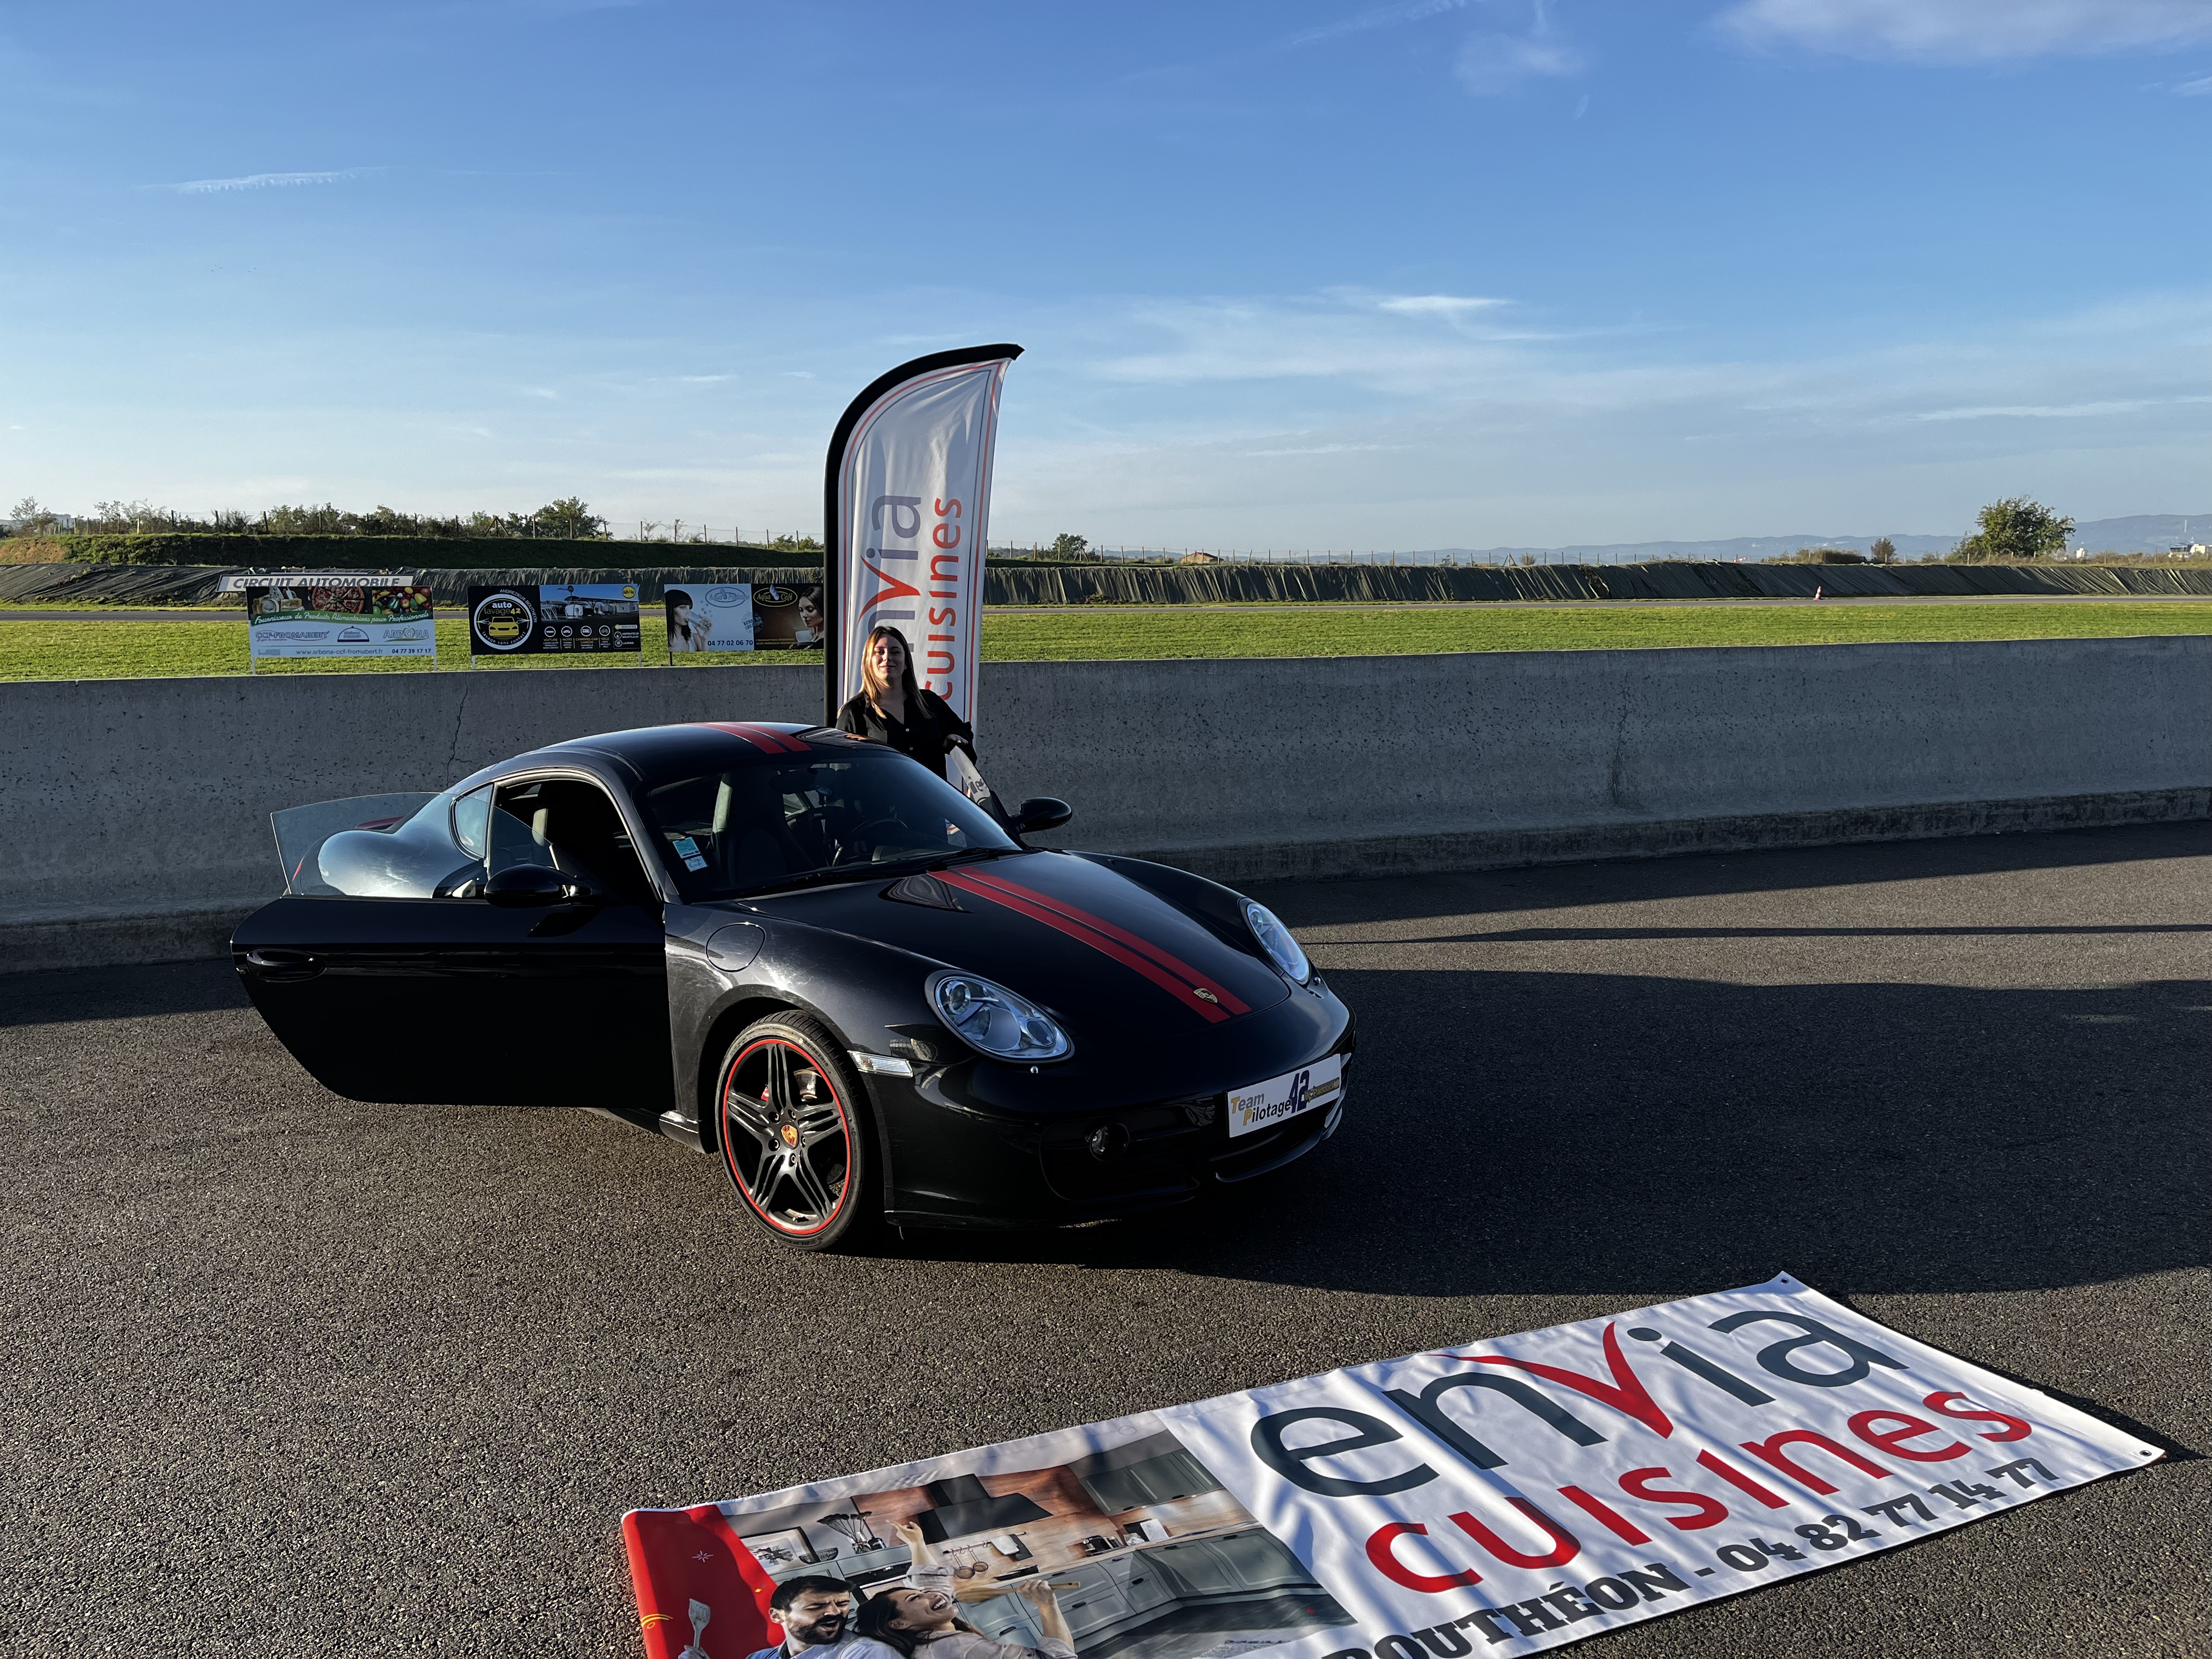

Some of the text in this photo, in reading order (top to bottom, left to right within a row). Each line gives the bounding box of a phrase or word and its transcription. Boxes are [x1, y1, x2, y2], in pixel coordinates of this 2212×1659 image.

[233, 578, 399, 588] CIRCUIT AUTOMOBILE
[857, 494, 922, 652] nvia
[255, 615, 292, 624] Fournisseur
[304, 612, 330, 620] Produits
[331, 613, 370, 622] Alimentaires
[388, 611, 429, 622] Professionnels
[383, 628, 430, 639] ARBONA
[482, 631, 496, 644] lavage
[1231, 1093, 1265, 1114] Team
[1243, 1070, 1310, 1126] Pilotage 42
[1250, 1310, 1909, 1497] envia
[1365, 1391, 2032, 1593] cuisines
[1716, 1535, 1808, 1572] 04
[1795, 1515, 1883, 1551] 82
[1860, 1493, 1939, 1528] 77
[1927, 1479, 2007, 1510] 14
[1984, 1457, 2061, 1489] 77
